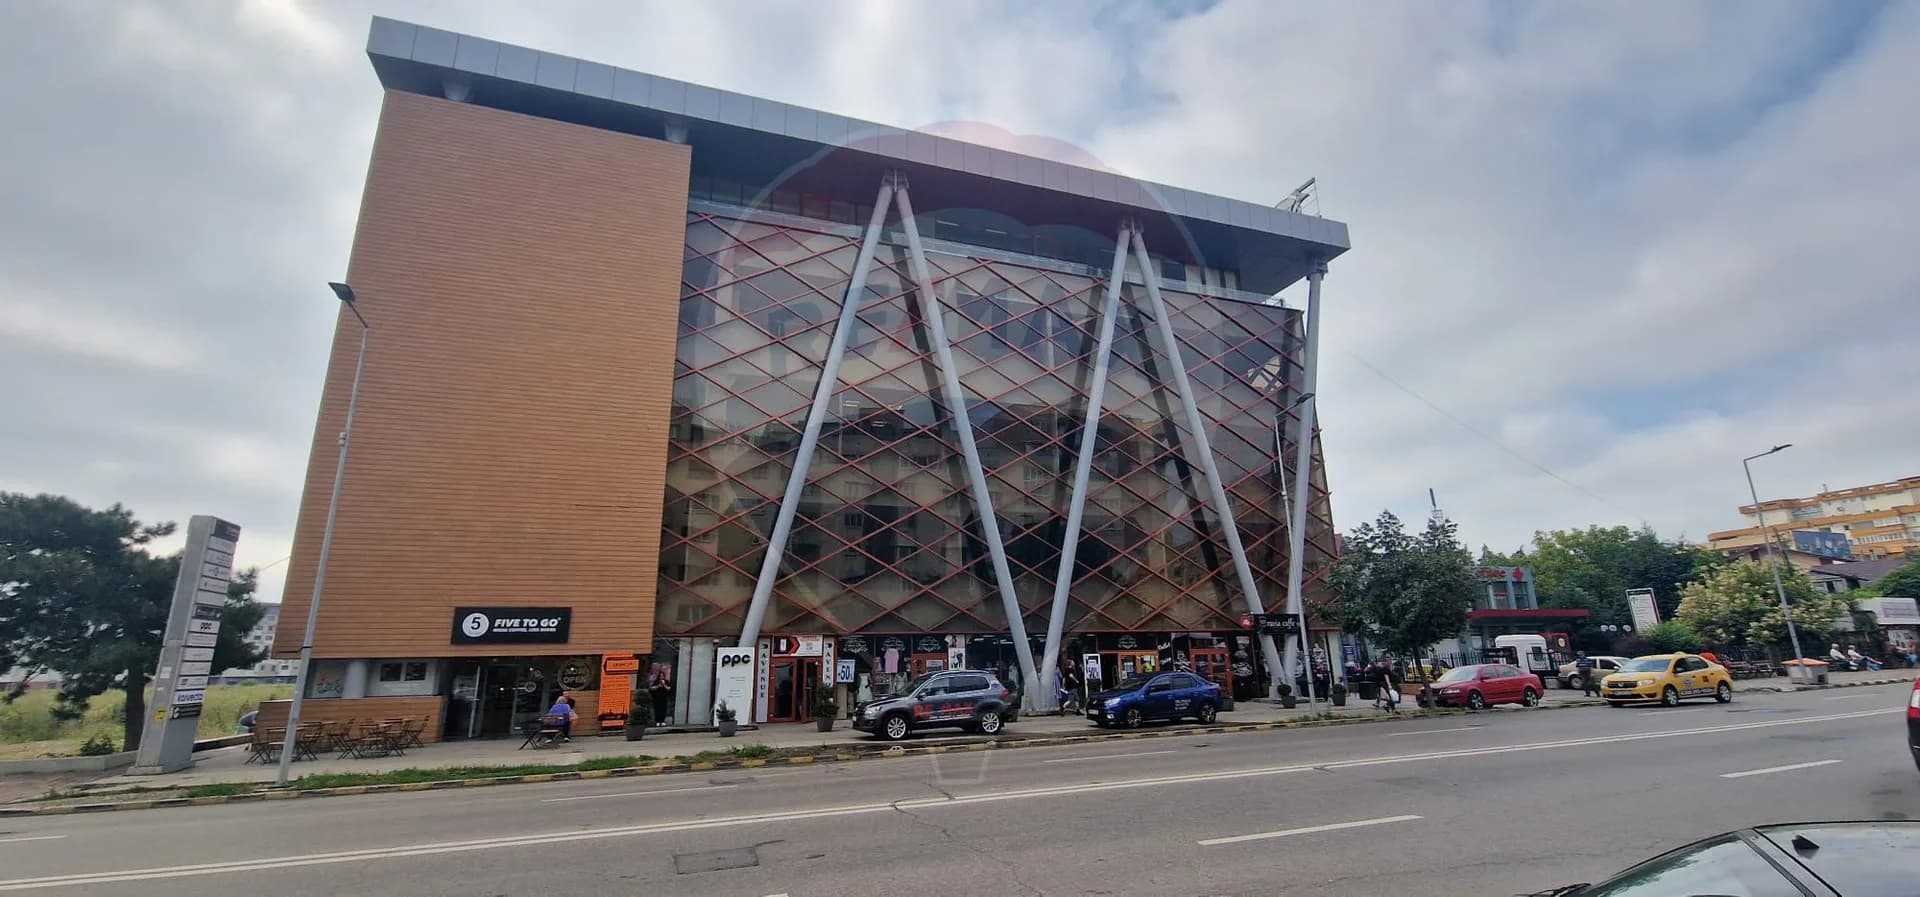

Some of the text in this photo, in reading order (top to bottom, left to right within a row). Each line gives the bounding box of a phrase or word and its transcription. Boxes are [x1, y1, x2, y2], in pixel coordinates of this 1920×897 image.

[470, 617, 481, 630] 5
[494, 618, 559, 627] FIVE TO GO
[722, 654, 751, 667] ppc
